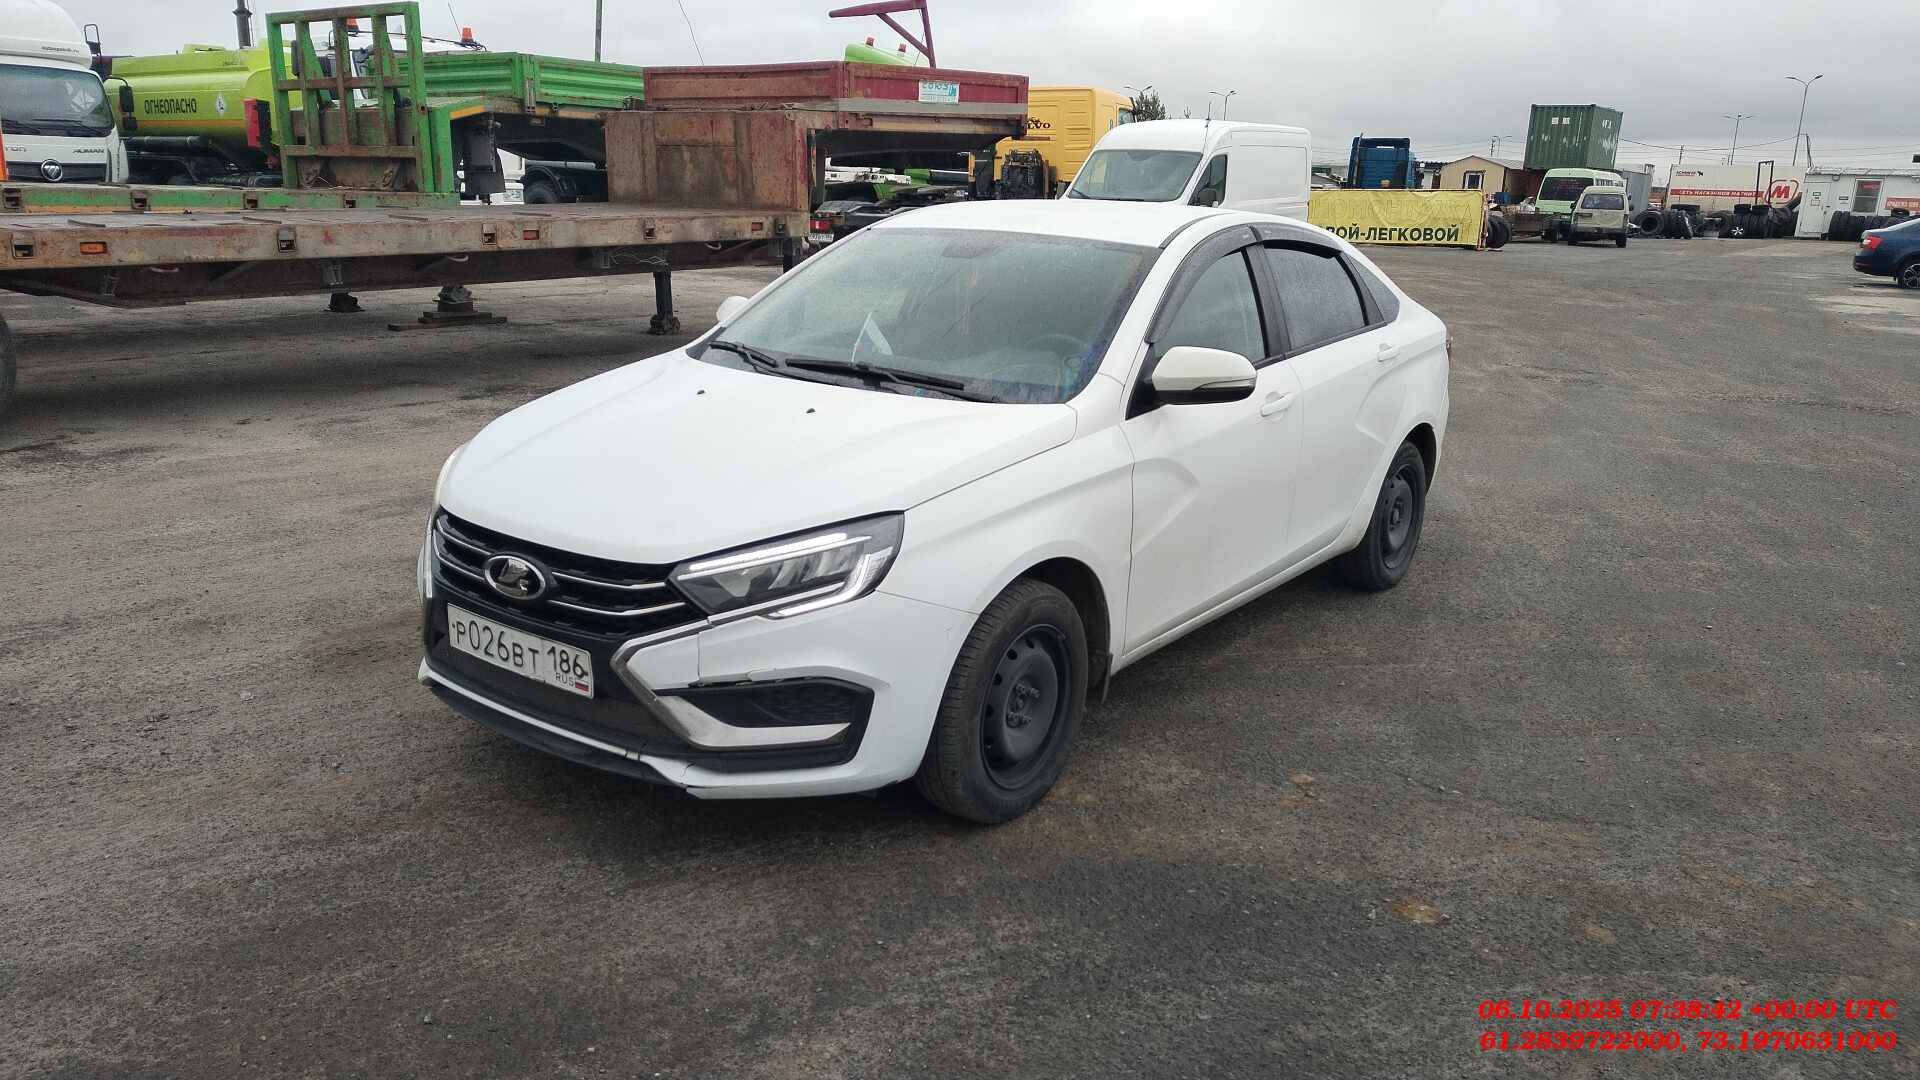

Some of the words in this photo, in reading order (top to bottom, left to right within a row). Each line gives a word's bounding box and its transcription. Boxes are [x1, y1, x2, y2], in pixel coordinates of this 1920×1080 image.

[144, 98, 197, 114] ОГНЕОПАСНО
[547, 645, 585, 679] 186
[555, 672, 575, 687] RUS
